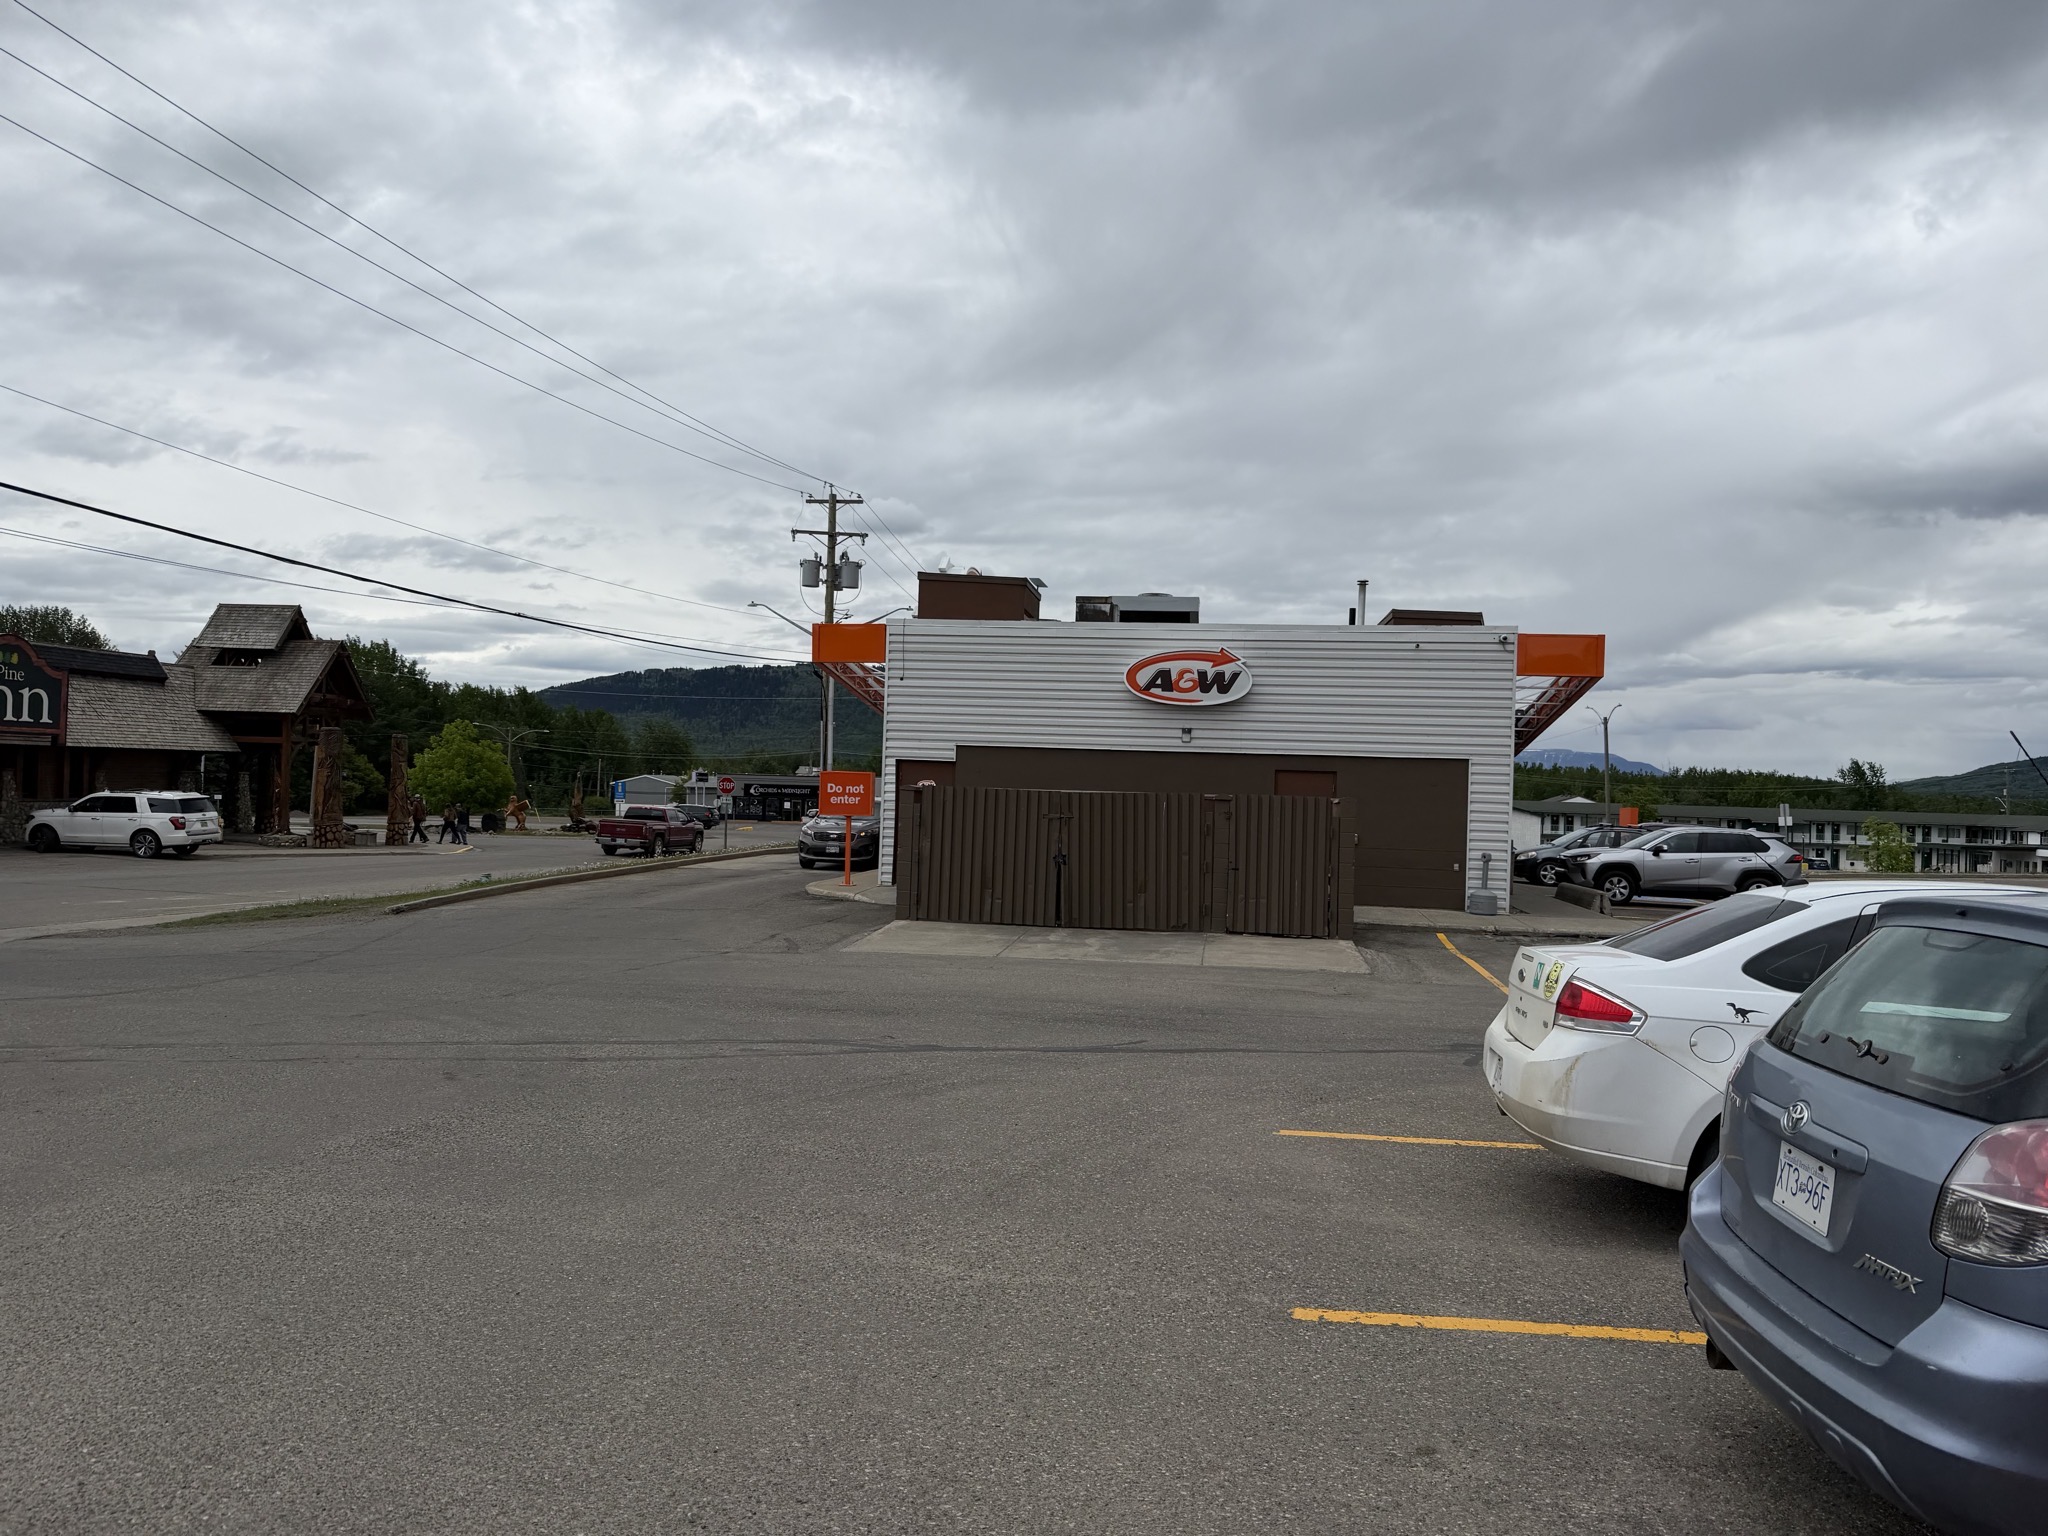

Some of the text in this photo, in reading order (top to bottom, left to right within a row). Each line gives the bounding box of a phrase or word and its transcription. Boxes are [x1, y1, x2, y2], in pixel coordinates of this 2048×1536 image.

[1140, 667, 1242, 695] A&W
[719, 782, 735, 790] STOP
[827, 783, 864, 793] Do not
[830, 795, 860, 804] enter
[1776, 1159, 1830, 1214] XT3 96F
[1853, 1253, 1923, 1294] MATRIX
